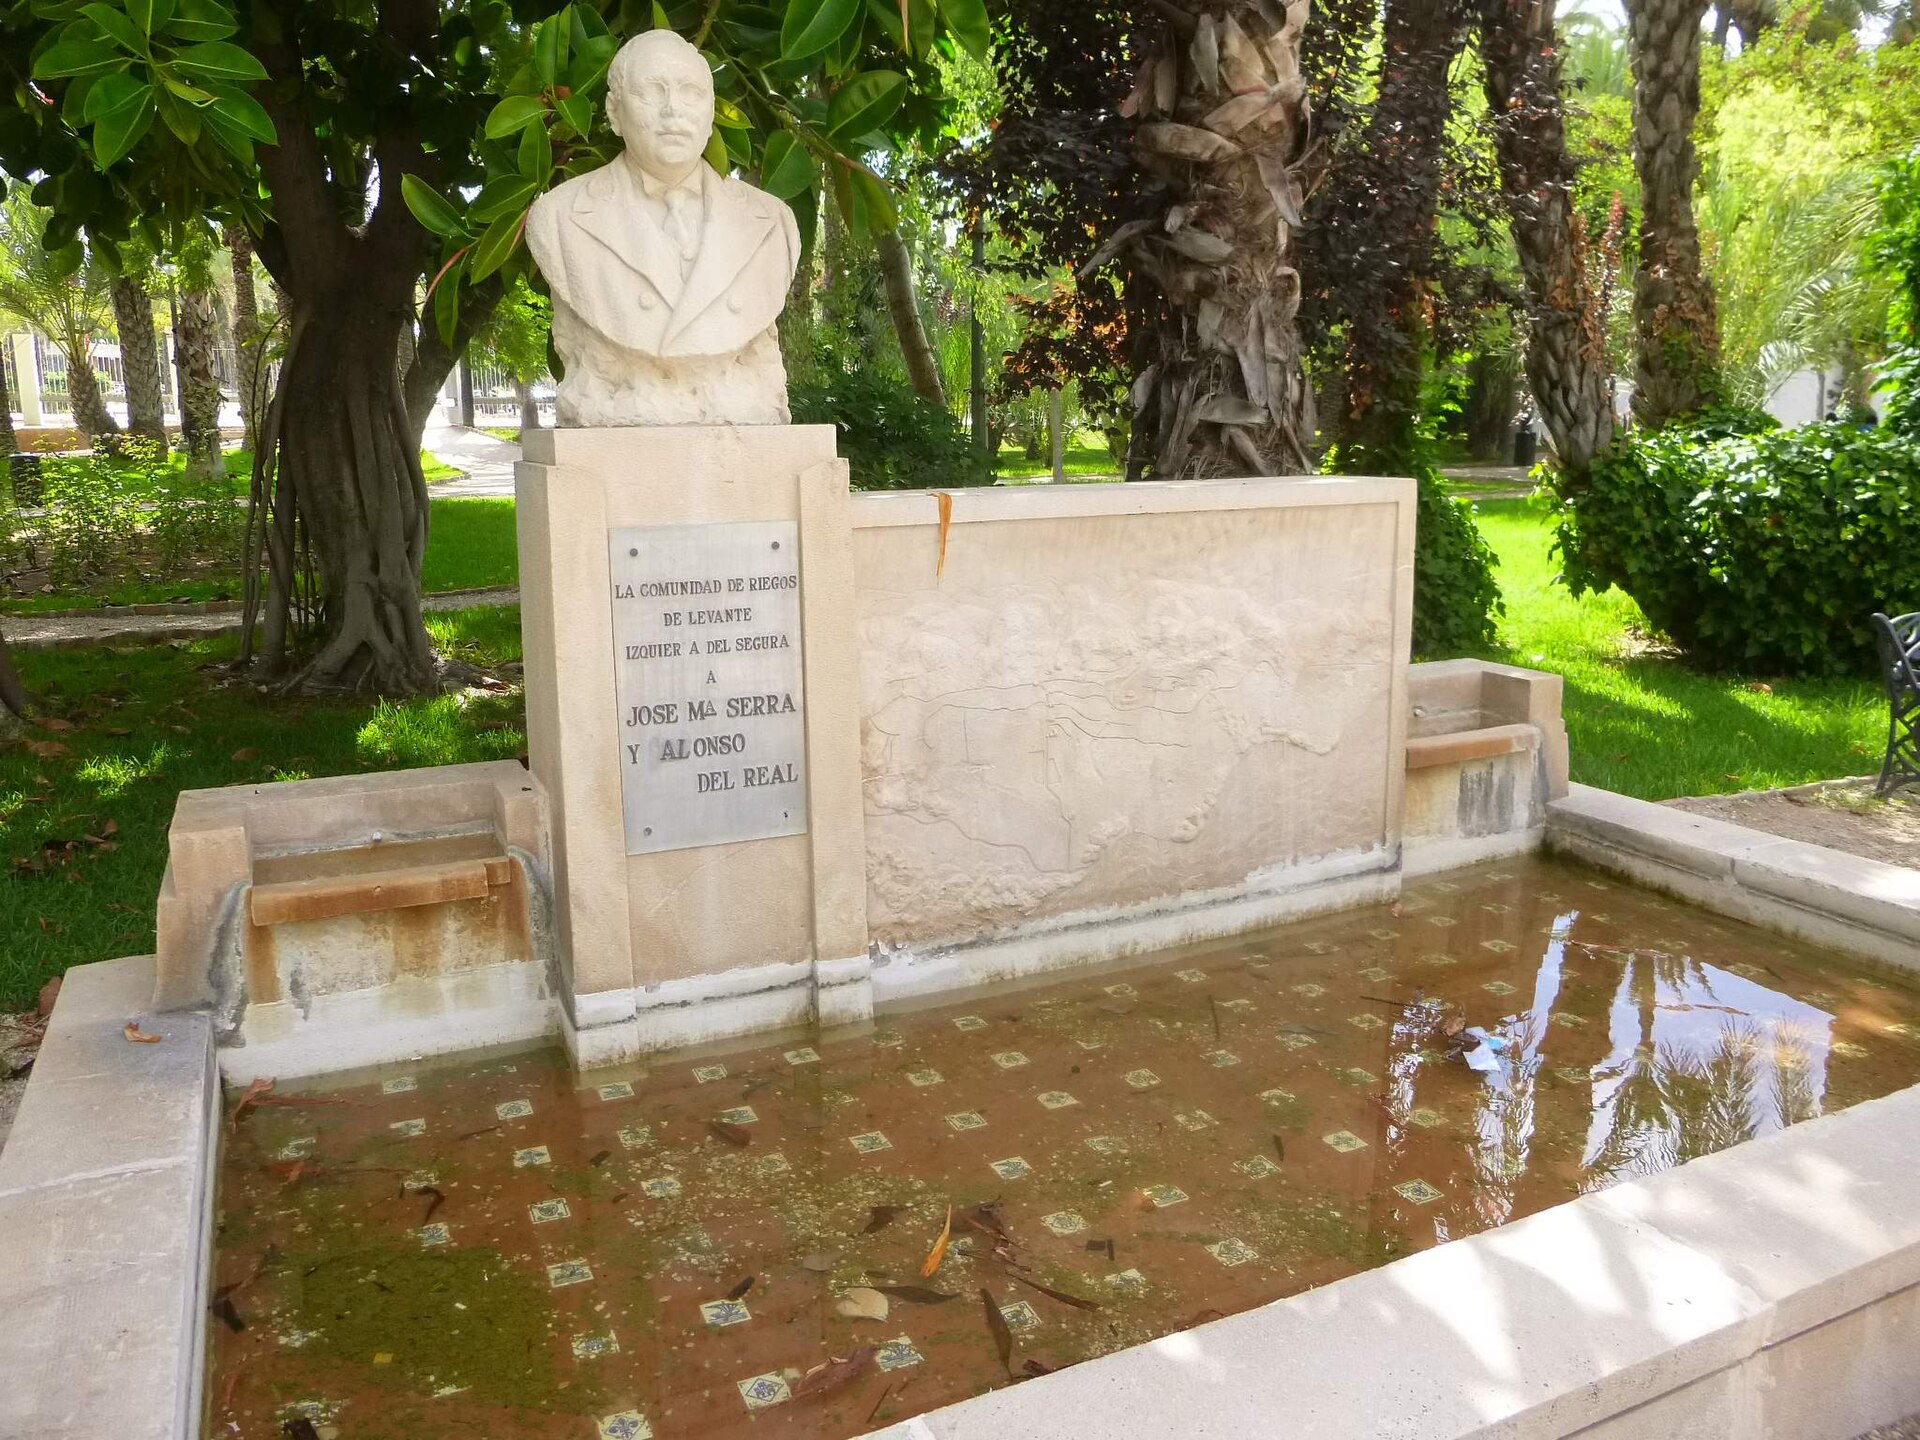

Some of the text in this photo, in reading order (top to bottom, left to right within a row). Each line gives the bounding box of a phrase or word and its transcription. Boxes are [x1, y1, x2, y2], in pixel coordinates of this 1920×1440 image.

[615, 576, 797, 599] LA COMUNIDAD DE RIEGOS
[663, 608, 752, 627] DE LEVANTE
[707, 639, 731, 654] DEL
[735, 635, 790, 652] SEGURA
[706, 670, 717, 684] A
[626, 703, 679, 727] JOSE
[726, 693, 796, 718] SERRA
[627, 733, 746, 764] Y ALONSO
[697, 763, 799, 793] DEL REAL
